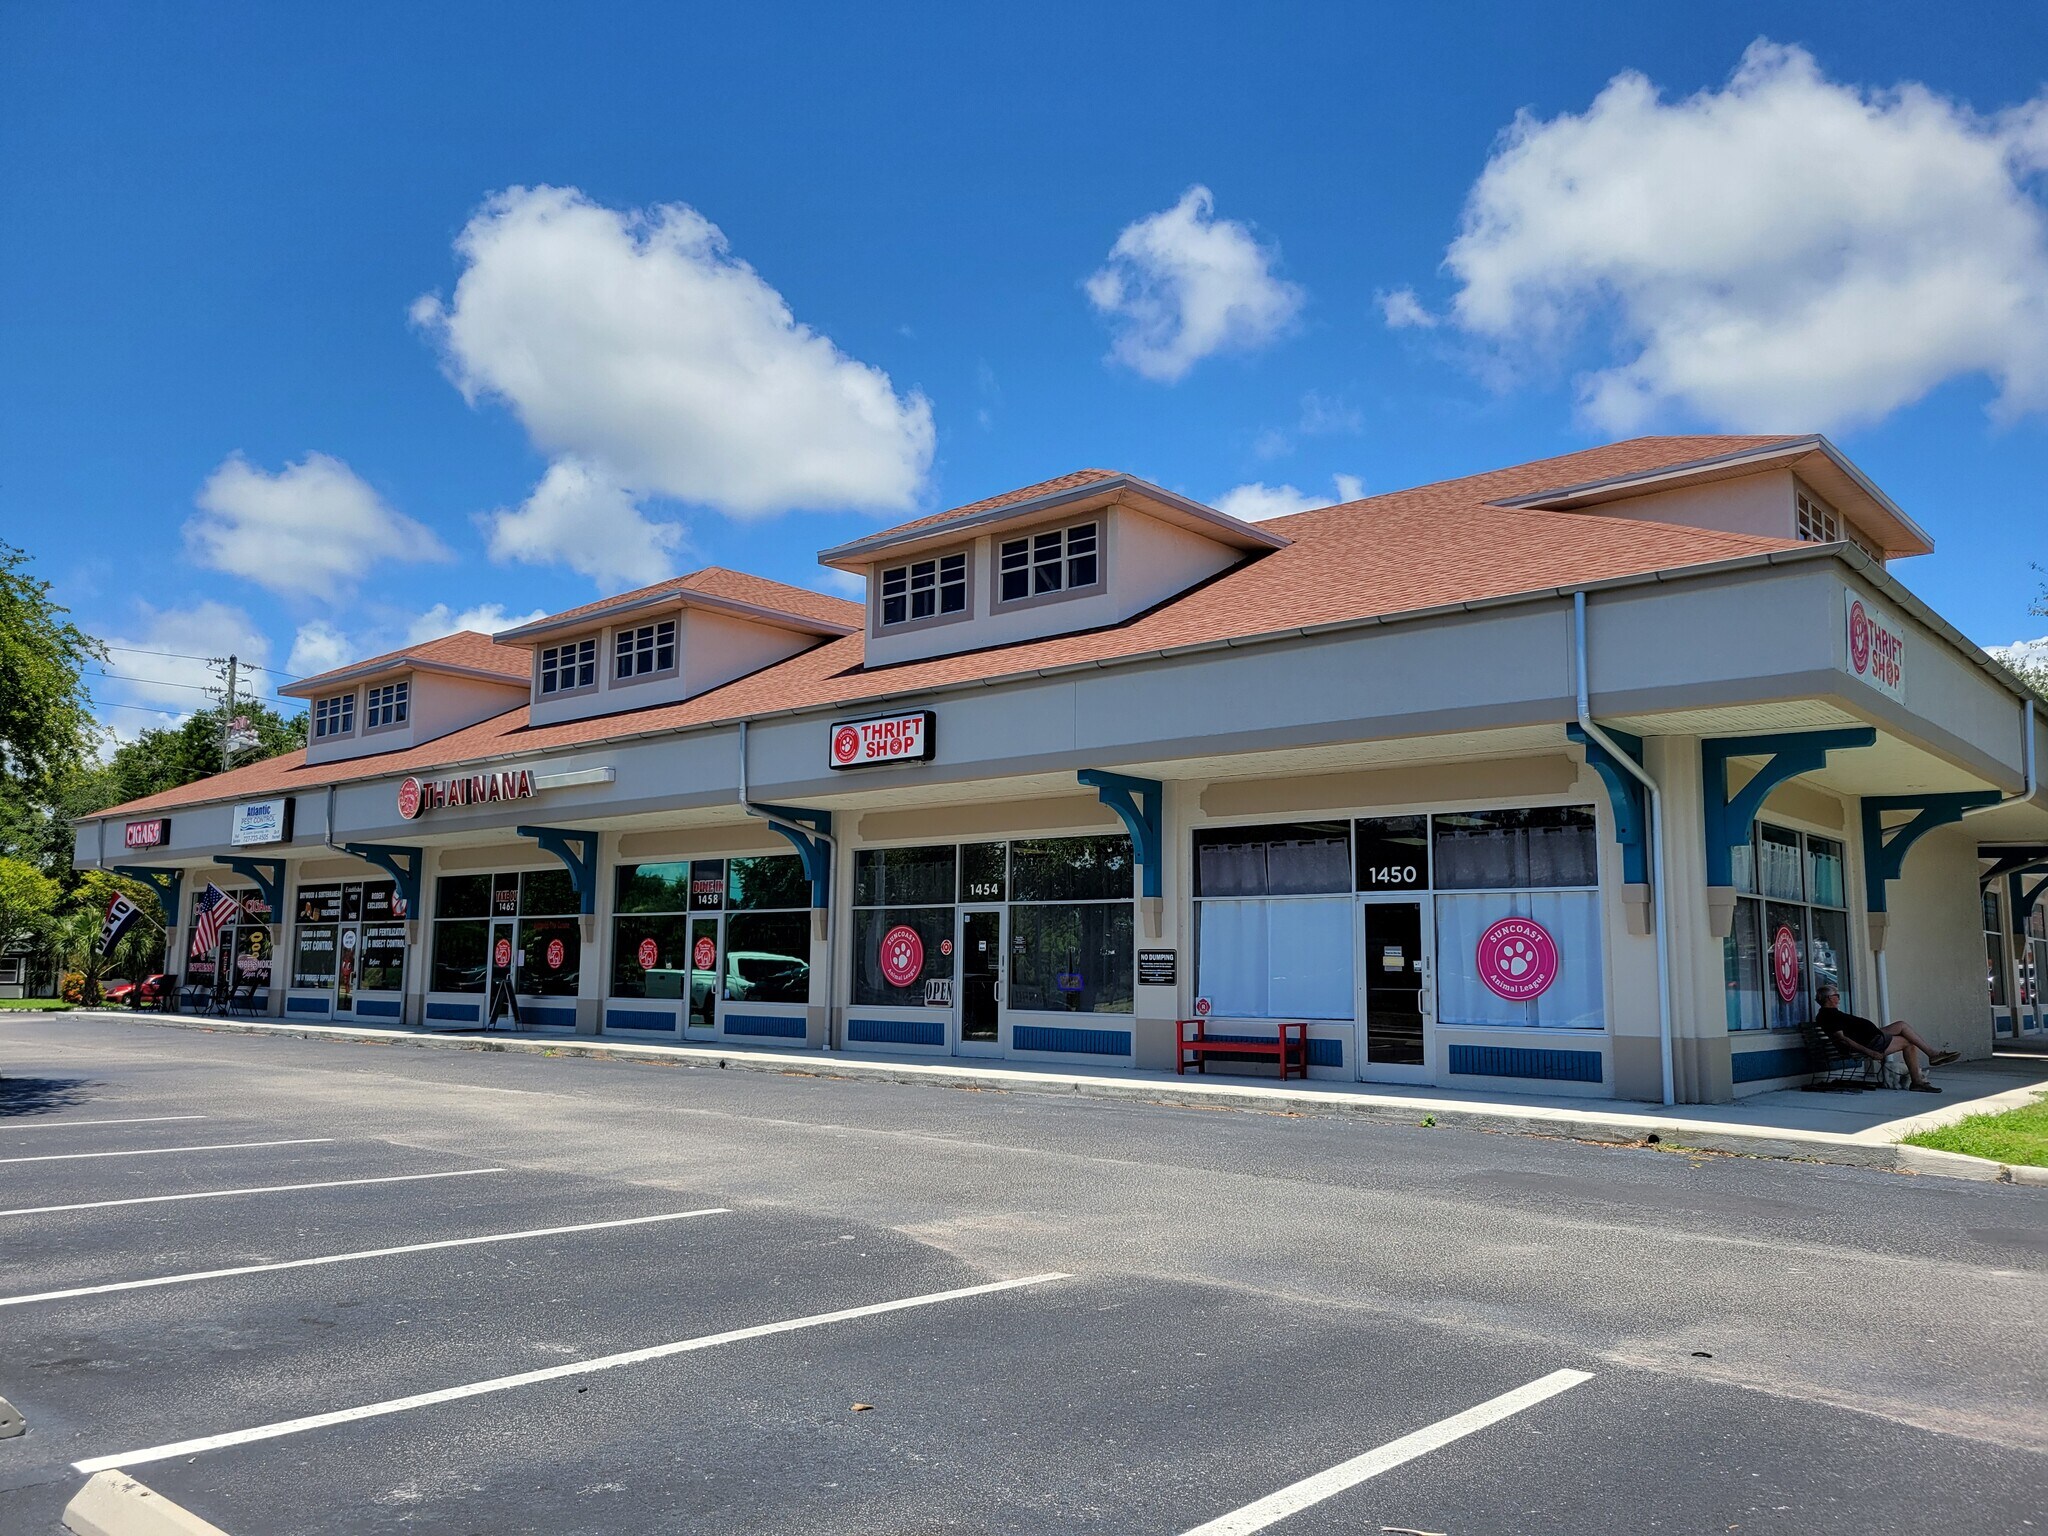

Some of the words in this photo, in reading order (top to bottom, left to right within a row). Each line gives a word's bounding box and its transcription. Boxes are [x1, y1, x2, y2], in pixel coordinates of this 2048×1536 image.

[1868, 618, 1903, 666] THRIFT
[1872, 649, 1900, 689] SHOP
[861, 718, 922, 741] THRIFT
[866, 736, 914, 758] SHOP
[423, 779, 467, 809] THAI
[472, 770, 534, 804] NANA
[247, 805, 271, 816] Atlantic
[127, 823, 159, 845] CIGARS
[1369, 866, 1417, 883] 1450
[693, 880, 714, 893] DINE
[970, 883, 998, 895] 1454
[500, 903, 515, 911] 1462
[698, 894, 719, 904] 1458
[97, 901, 130, 951] OPEN
[1490, 925, 1543, 943] SUNCOAST
[301, 941, 312, 950] PEST
[313, 941, 333, 950] CONTROL
[887, 931, 916, 946] SUNCOAST
[888, 968, 902, 980] Animal
[903, 965, 917, 980] League
[926, 981, 953, 1000] OPEN
[1490, 974, 1518, 992] Animal
[1520, 973, 1545, 992] League
